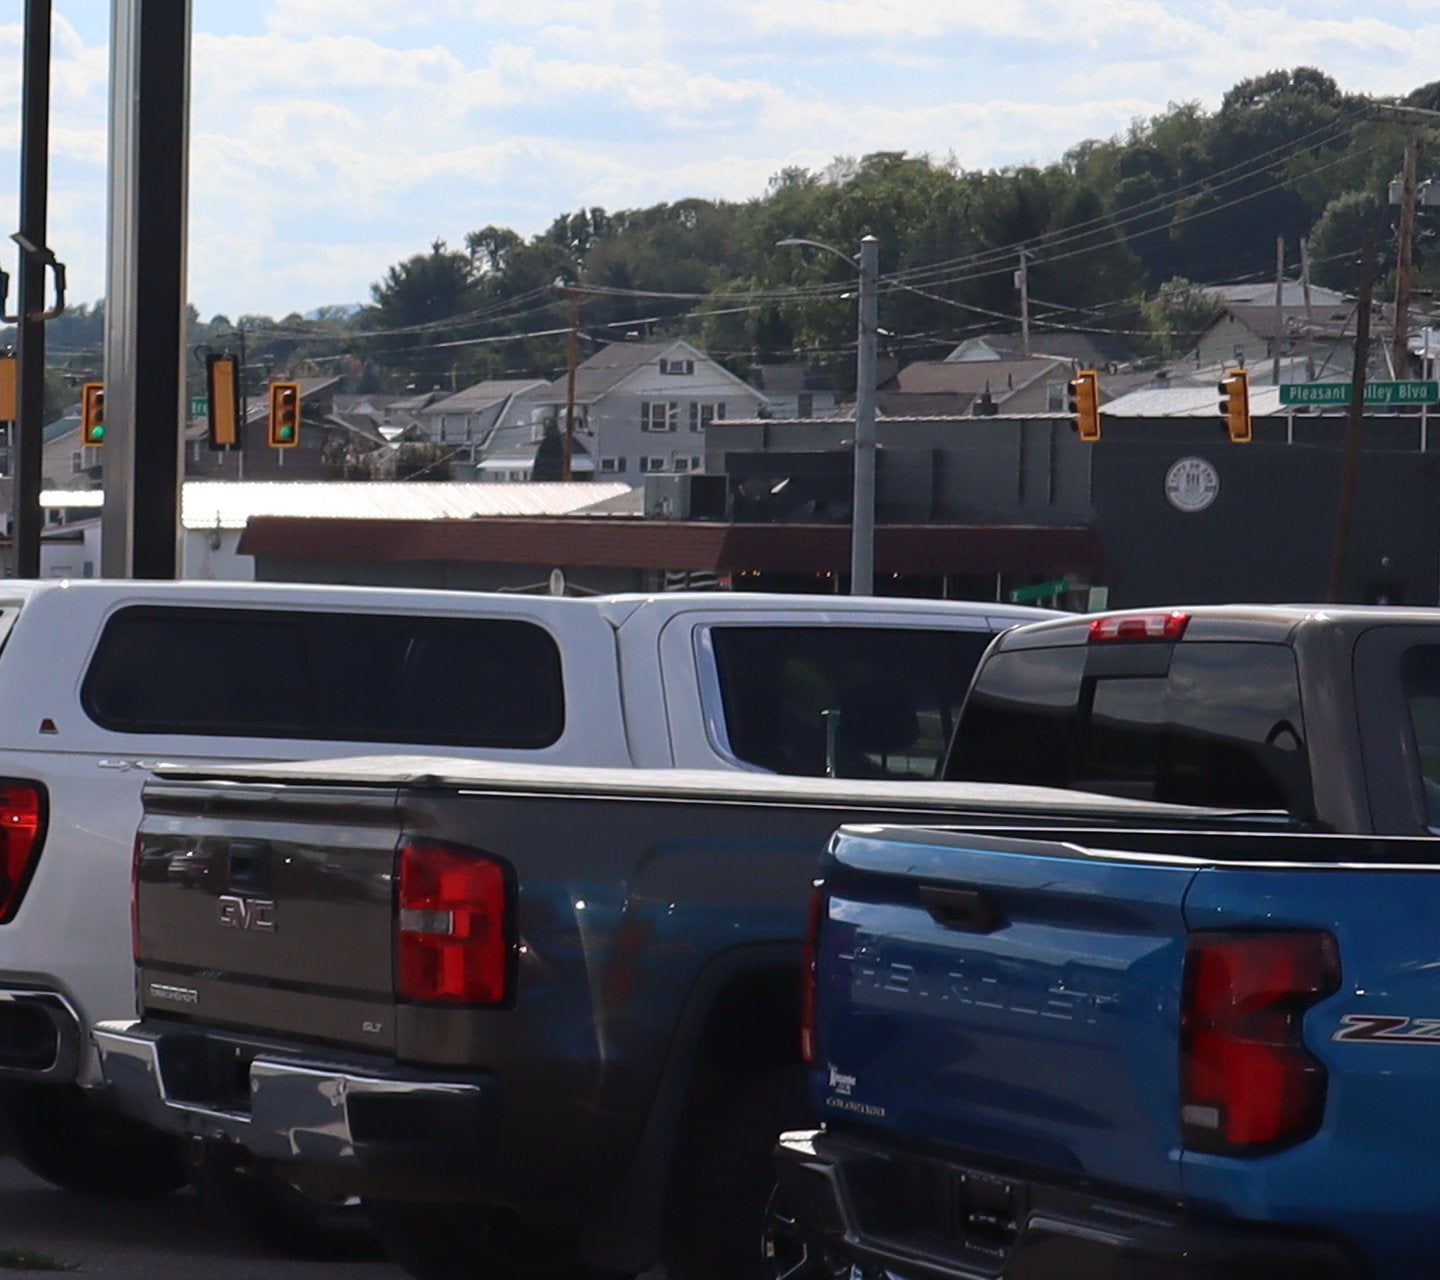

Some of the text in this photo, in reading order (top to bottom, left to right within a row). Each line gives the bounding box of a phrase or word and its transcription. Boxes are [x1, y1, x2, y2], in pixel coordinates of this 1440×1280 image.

[1289, 386, 1346, 400] Pleasant
[1399, 385, 1428, 398] Blvd
[219, 894, 277, 932] GMC
